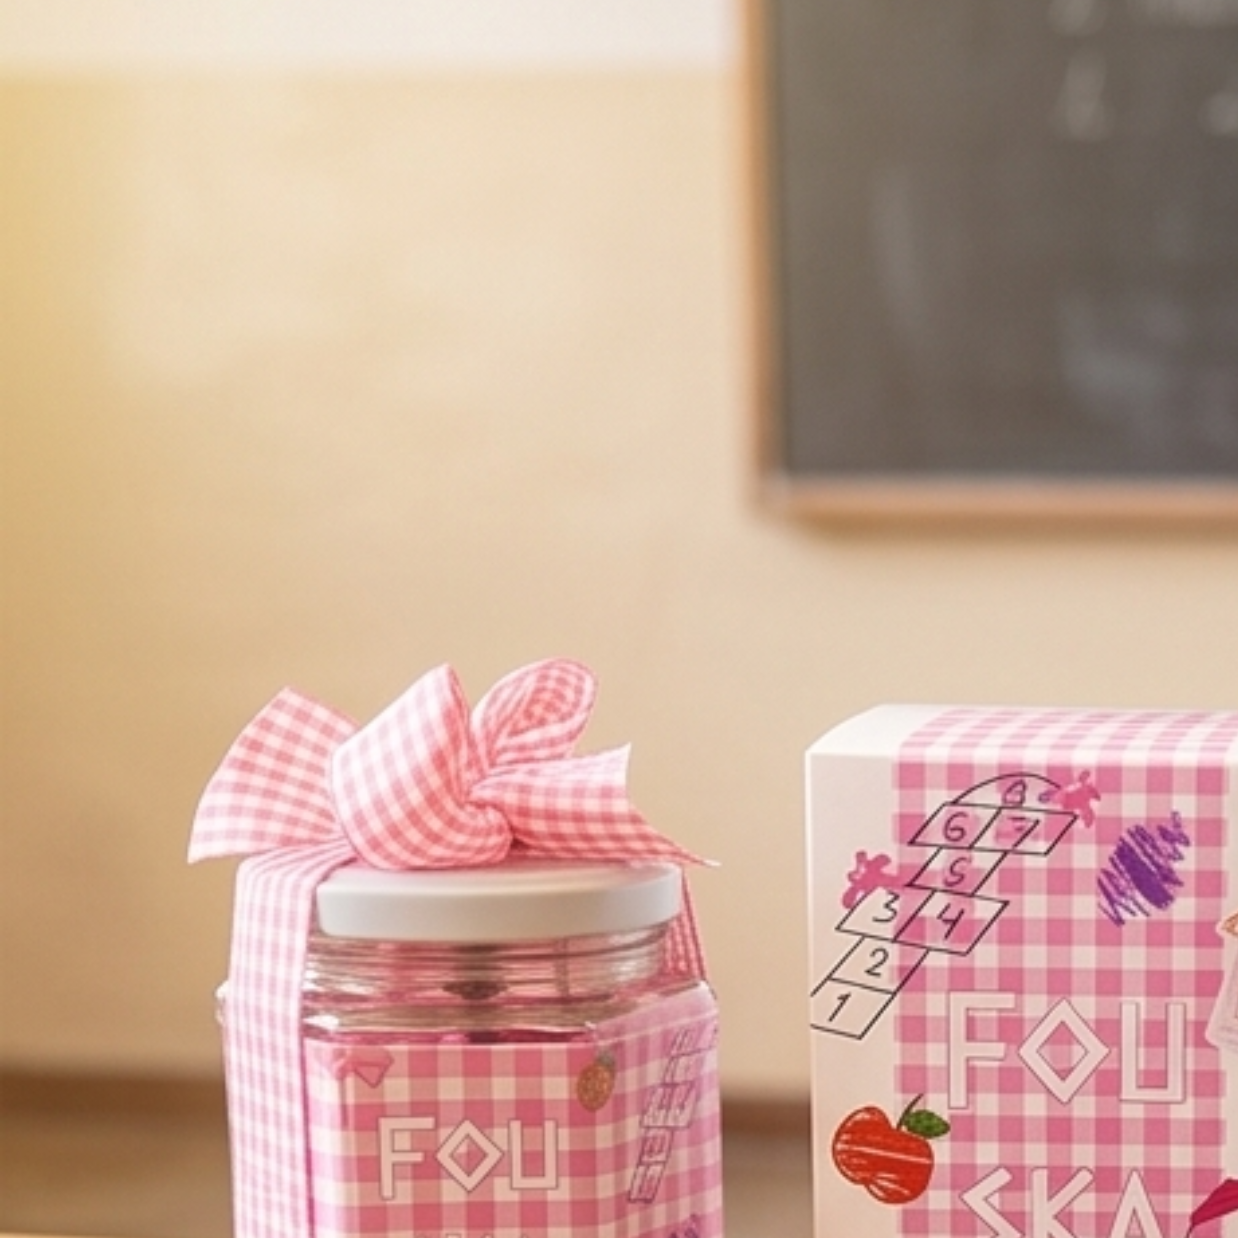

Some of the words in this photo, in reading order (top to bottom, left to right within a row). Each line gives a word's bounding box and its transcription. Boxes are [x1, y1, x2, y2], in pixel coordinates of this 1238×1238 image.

[943, 811, 967, 842] 6
[1006, 815, 1040, 849] 7
[872, 891, 900, 923] 3
[936, 903, 965, 941] 4
[864, 947, 889, 977] 2
[828, 992, 852, 1023] 1
[947, 990, 1186, 1109] FOU
[378, 1117, 559, 1200] FOU
